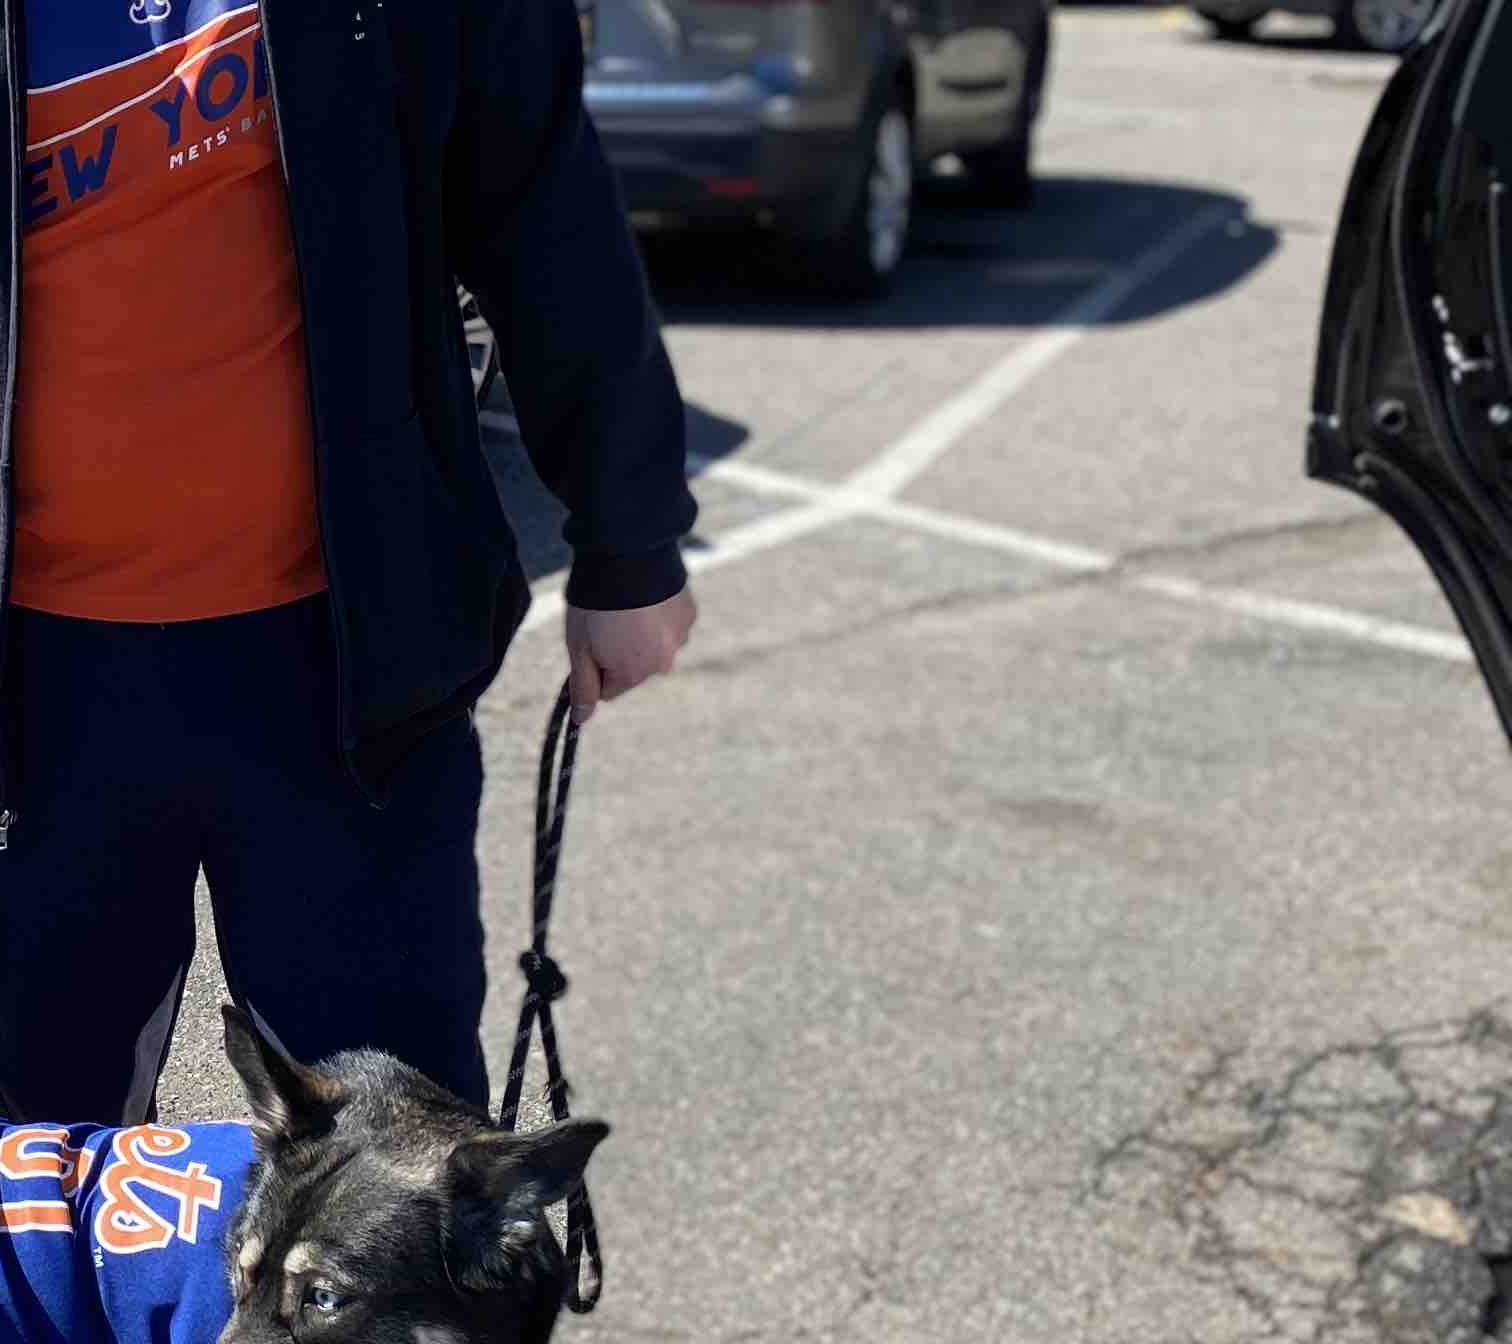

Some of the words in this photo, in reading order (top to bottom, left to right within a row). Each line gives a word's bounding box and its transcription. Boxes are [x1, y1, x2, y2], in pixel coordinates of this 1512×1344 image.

[22, 124, 118, 227] EW
[151, 39, 268, 148] YO
[95, 1122, 222, 1254] ets
